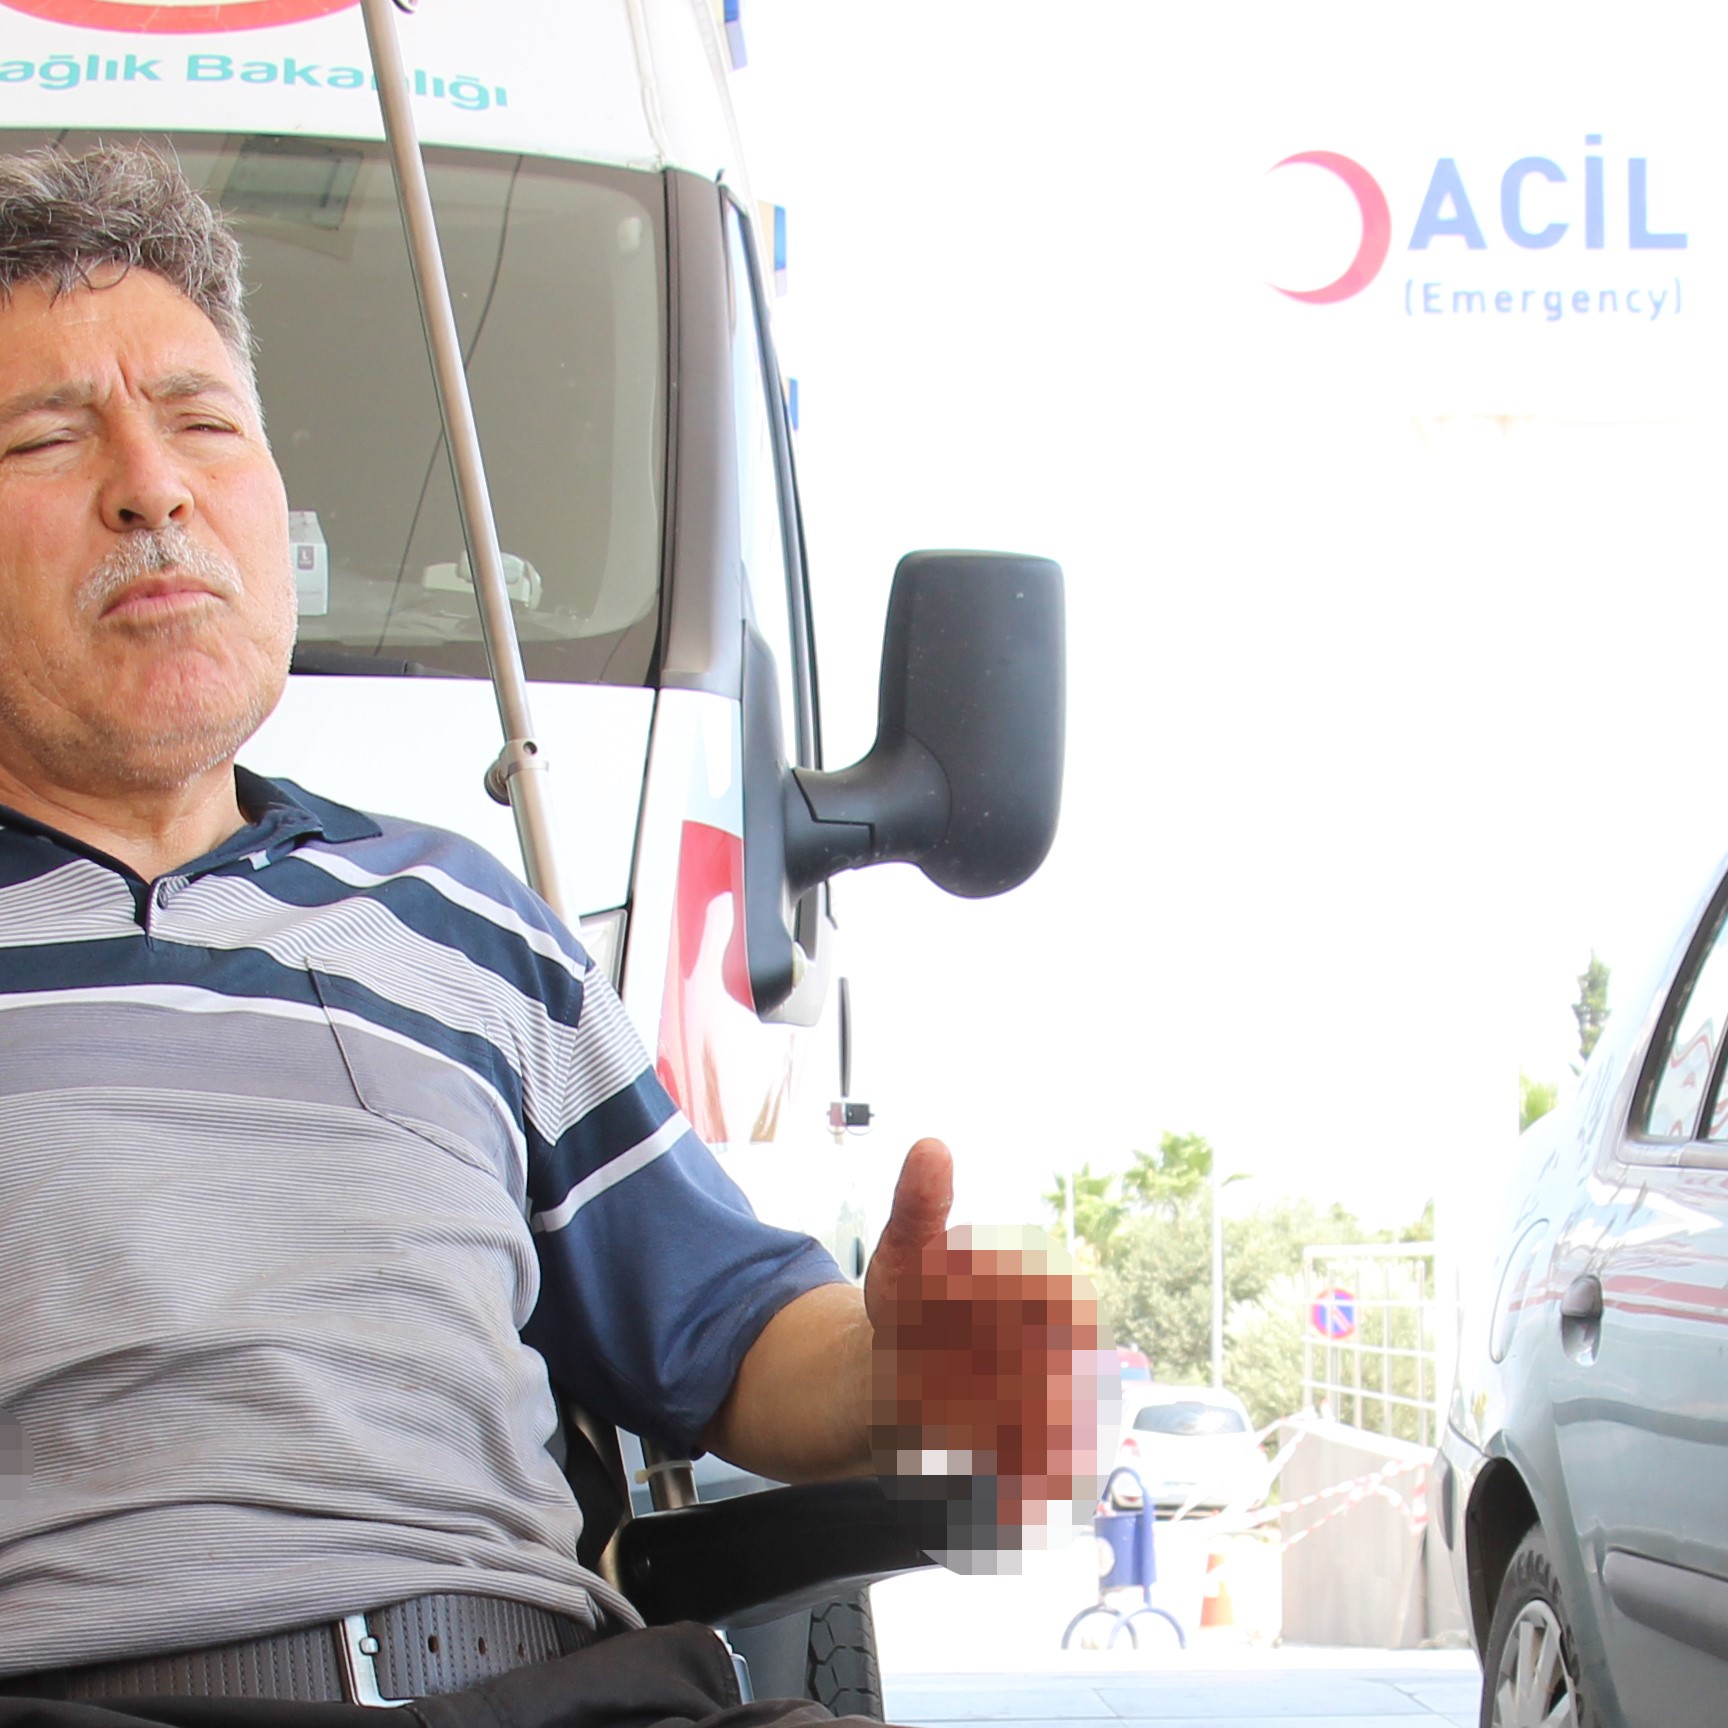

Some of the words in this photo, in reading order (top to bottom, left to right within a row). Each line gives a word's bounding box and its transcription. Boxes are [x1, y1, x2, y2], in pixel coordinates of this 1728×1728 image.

[185, 53, 509, 111] Bakalığı
[1406, 132, 1689, 251] ACİL
[1404, 277, 1683, 321] (Emergency)
